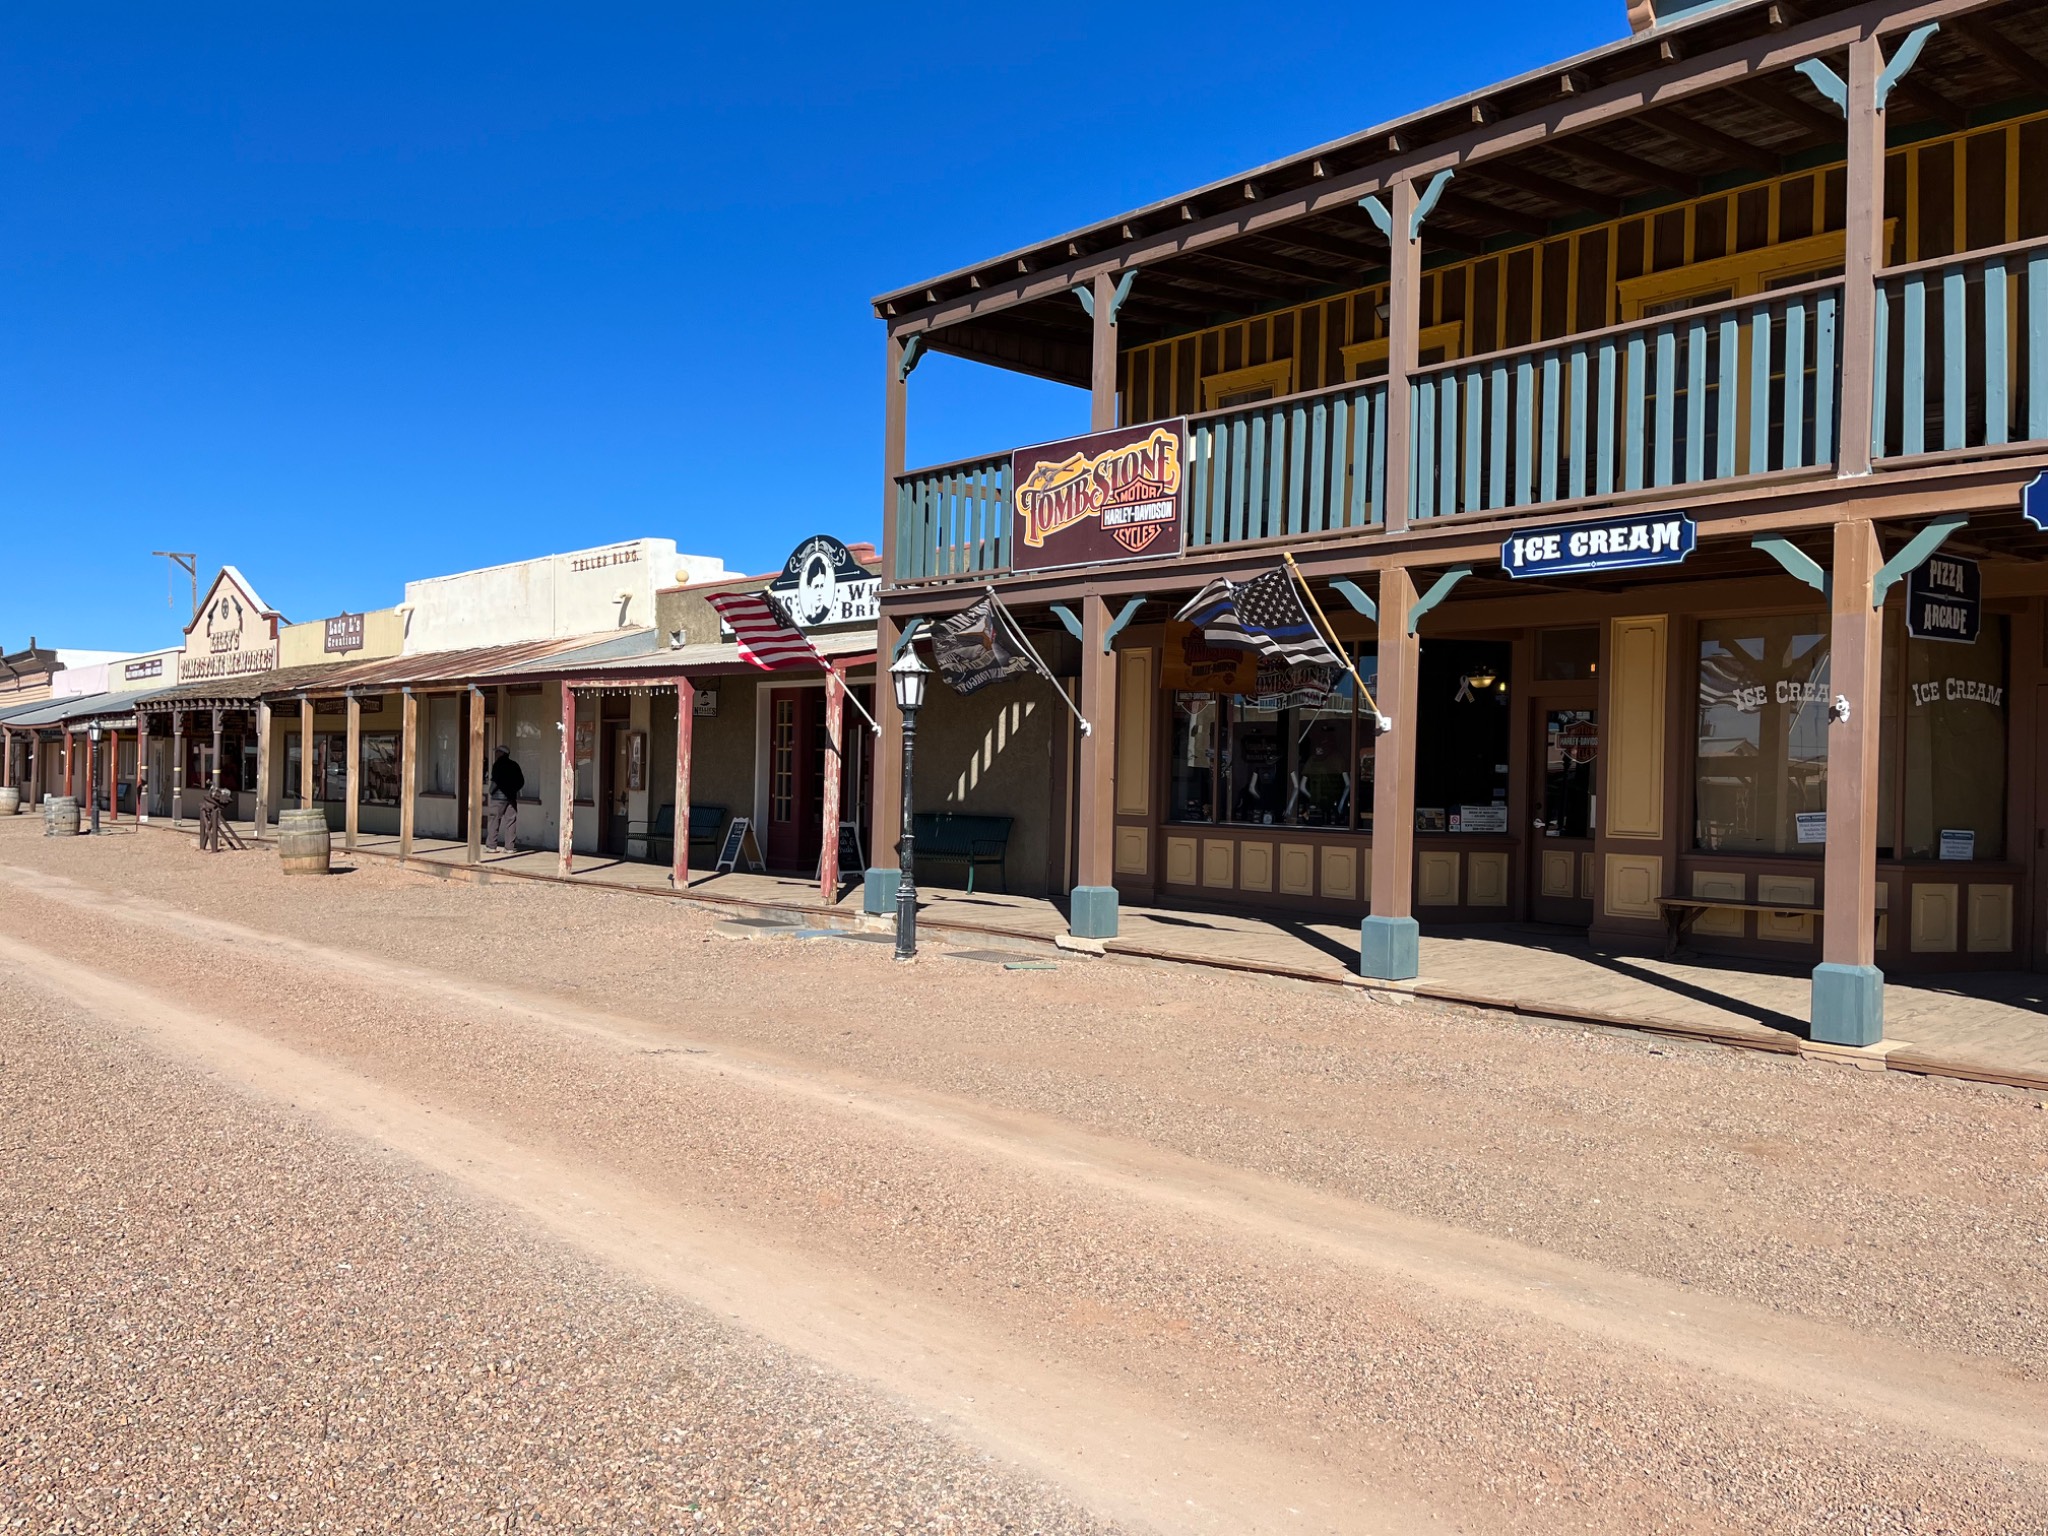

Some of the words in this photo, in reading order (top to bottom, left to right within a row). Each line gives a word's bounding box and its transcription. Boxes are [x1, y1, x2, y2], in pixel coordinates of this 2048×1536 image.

[1021, 436, 1175, 541] TOMBSTONE
[1119, 482, 1157, 502] MOTOR
[1104, 501, 1173, 526] HARLEY-DAVIDSON
[1117, 525, 1157, 548] CYCLES
[1513, 534, 1561, 567] ICE
[1568, 520, 1681, 558] CREAM
[1929, 559, 1964, 593] PIZZA
[328, 619, 346, 637] Lady
[349, 617, 360, 633] L's
[1923, 603, 1968, 634] ARCADE
[327, 635, 360, 648] Creations
[180, 655, 225, 680] TOMBSTONE
[226, 648, 273, 675] MEMORIES
[1256, 665, 1330, 694] OMBSTONE
[1912, 682, 1940, 706] ICE
[1946, 678, 2003, 706] CREAM
[1733, 685, 1768, 711] ICE
[1776, 680, 1830, 704] CREA
[1561, 737, 1599, 746] HARLEY-DAVIDS
